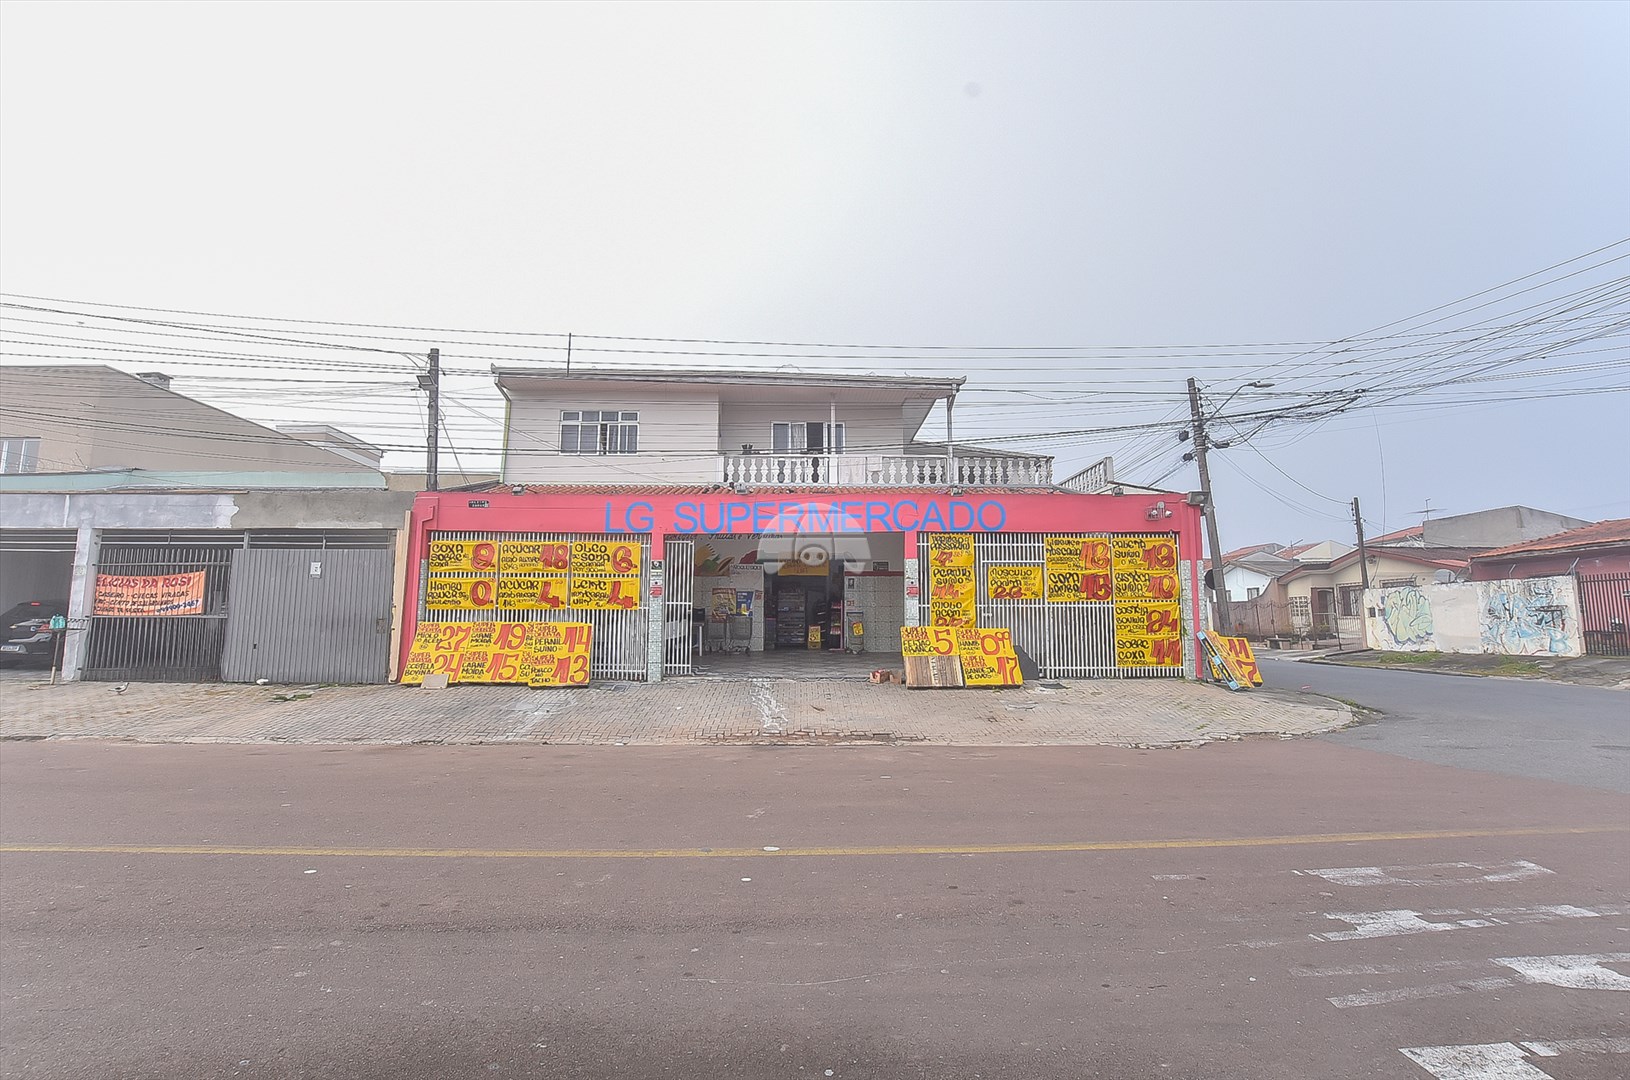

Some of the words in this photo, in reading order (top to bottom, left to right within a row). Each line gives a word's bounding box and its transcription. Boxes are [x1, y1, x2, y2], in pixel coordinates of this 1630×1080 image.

[604, 501, 655, 533] LG
[673, 500, 1007, 533] SUPERMERCADO
[432, 543, 463, 555] COXA
[162, 576, 192, 588] ROSI
[1049, 572, 1080, 584] COPA
[435, 625, 472, 652] 27
[493, 623, 527, 650] 19
[563, 625, 592, 653] 14
[933, 629, 954, 655] 5
[1117, 639, 1150, 649] SOBRE
[485, 653, 520, 681] 15
[1118, 650, 1145, 660] COXA
[551, 655, 588, 684] 13
[996, 656, 1018, 684] 17
